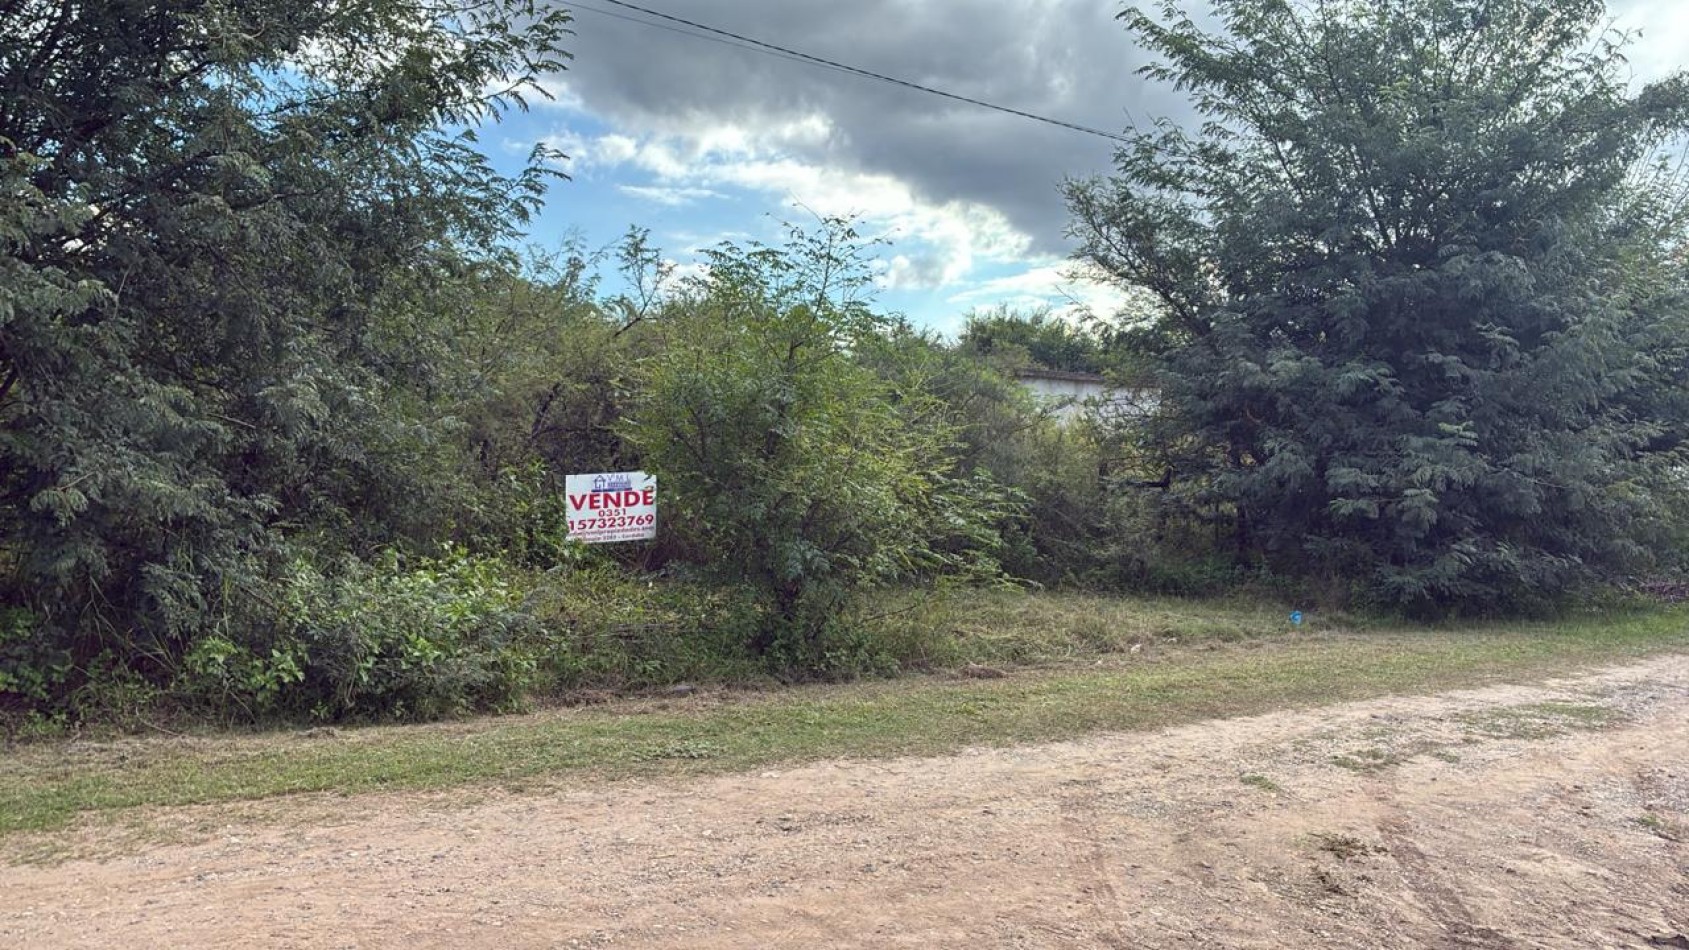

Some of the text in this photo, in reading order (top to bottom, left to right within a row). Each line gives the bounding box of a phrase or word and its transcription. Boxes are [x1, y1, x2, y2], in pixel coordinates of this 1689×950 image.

[569, 490, 654, 510] VENDE
[598, 508, 627, 517] 0351
[568, 514, 654, 530] 157323769
